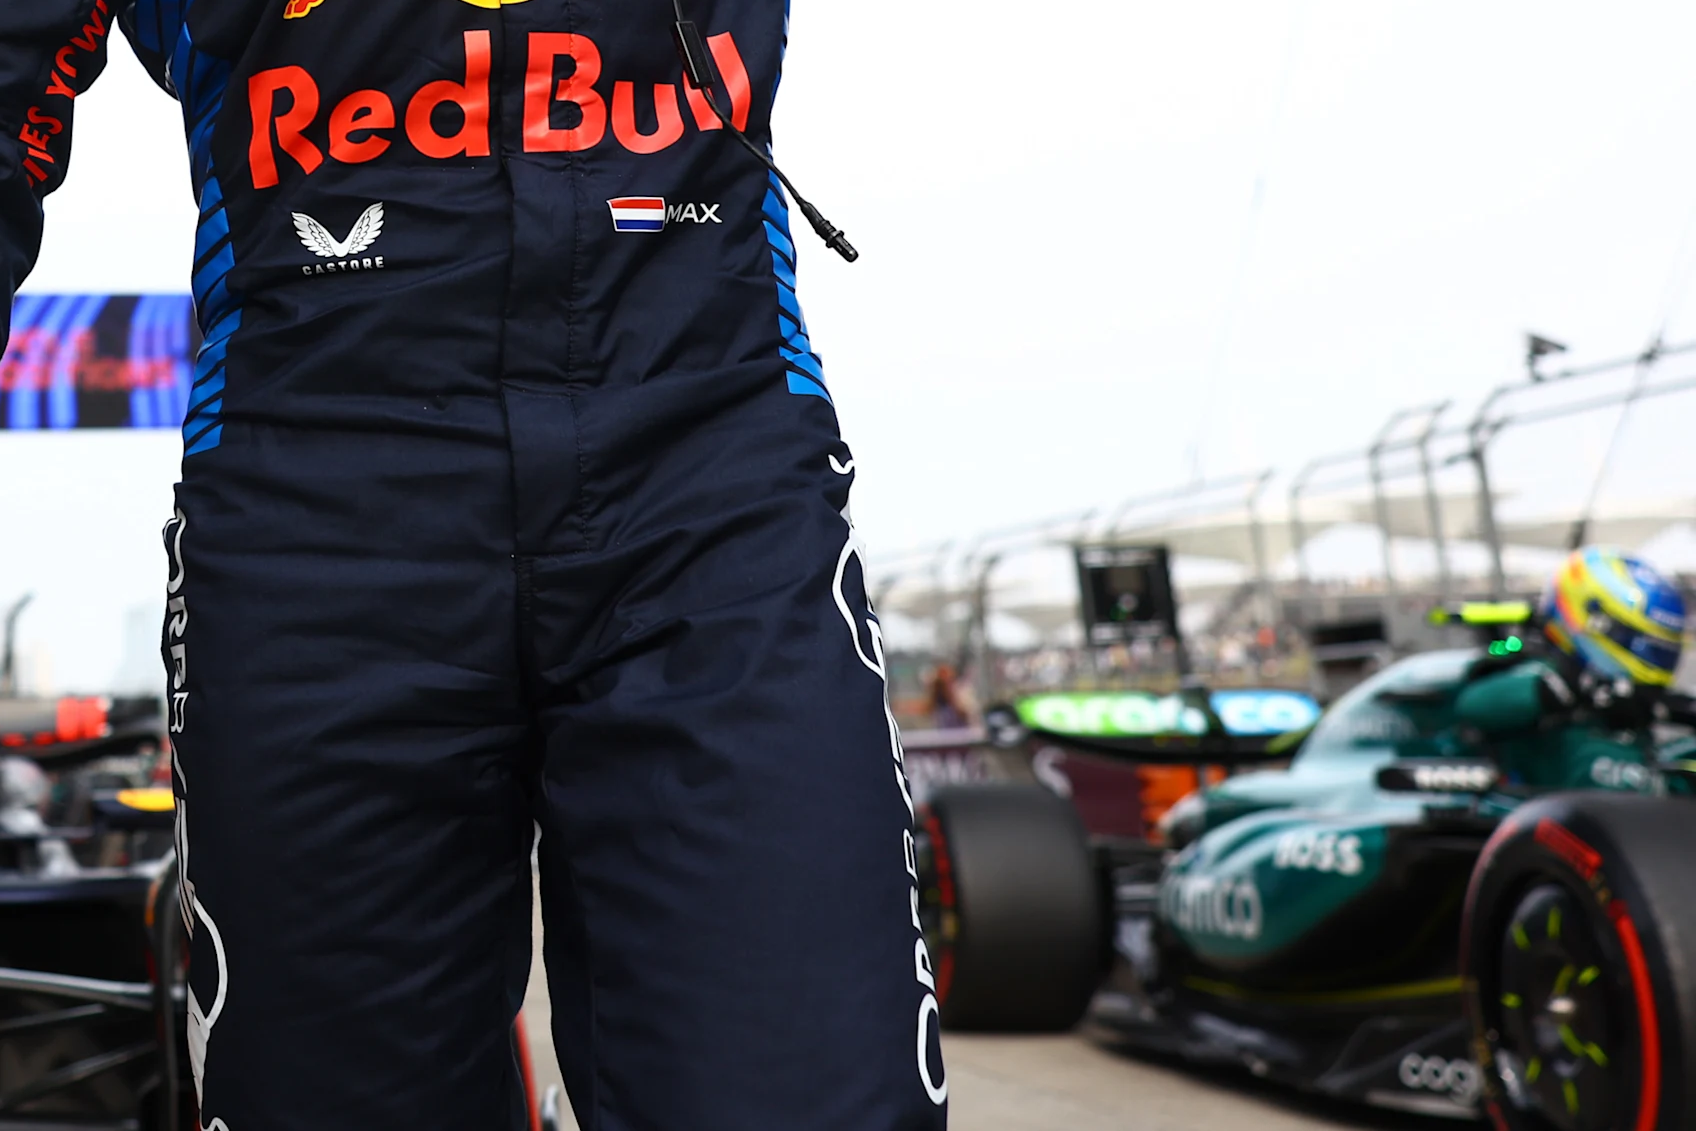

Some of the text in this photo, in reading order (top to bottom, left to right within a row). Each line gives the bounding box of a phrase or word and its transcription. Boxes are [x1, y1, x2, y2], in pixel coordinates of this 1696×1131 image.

[247, 29, 752, 189] Red Bull
[664, 201, 723, 225] MAX
[302, 256, 385, 276] CASTORE
